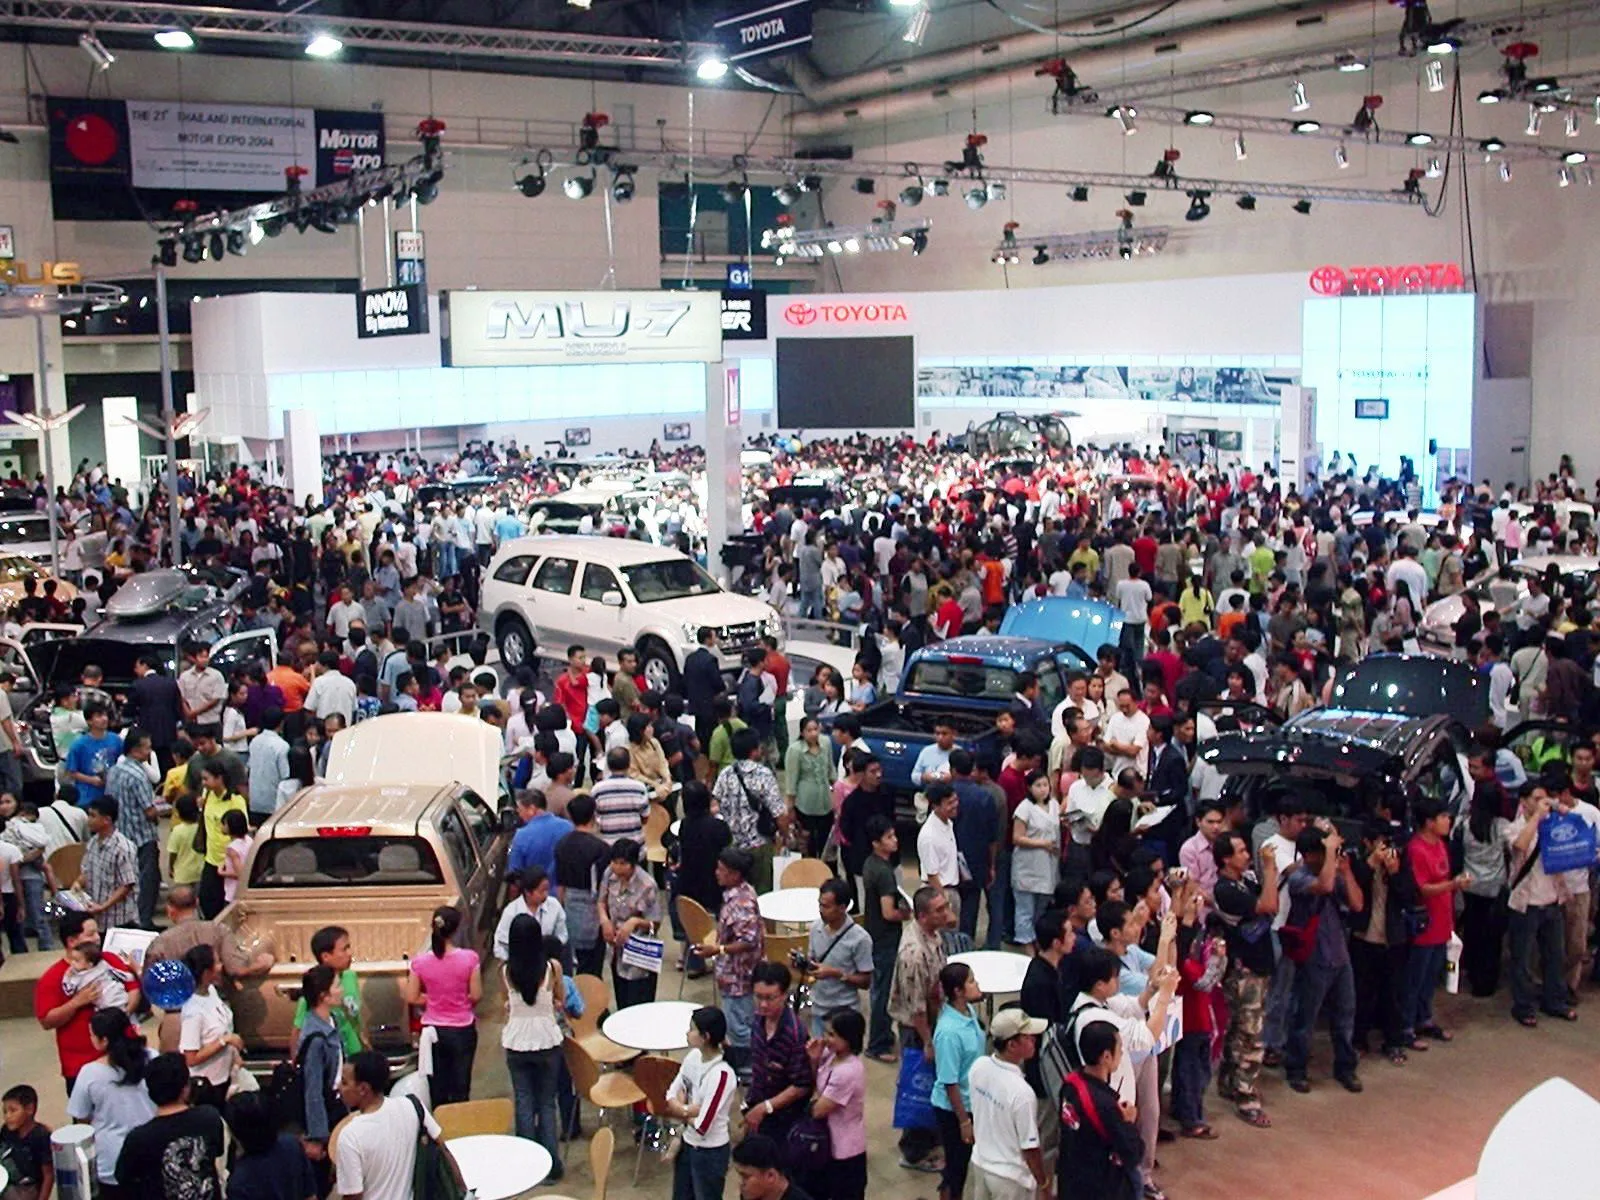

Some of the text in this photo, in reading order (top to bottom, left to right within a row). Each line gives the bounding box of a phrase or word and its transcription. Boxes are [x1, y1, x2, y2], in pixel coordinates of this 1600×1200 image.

[740, 18, 785, 43] TOYOTA
[178, 133, 213, 144] MOTOR
[217, 135, 246, 146] EXPO
[320, 129, 378, 148] MOTOR
[1350, 263, 1464, 290] TOYOTA
[486, 299, 692, 339] MU-7
[820, 304, 907, 322] TOYOTA
